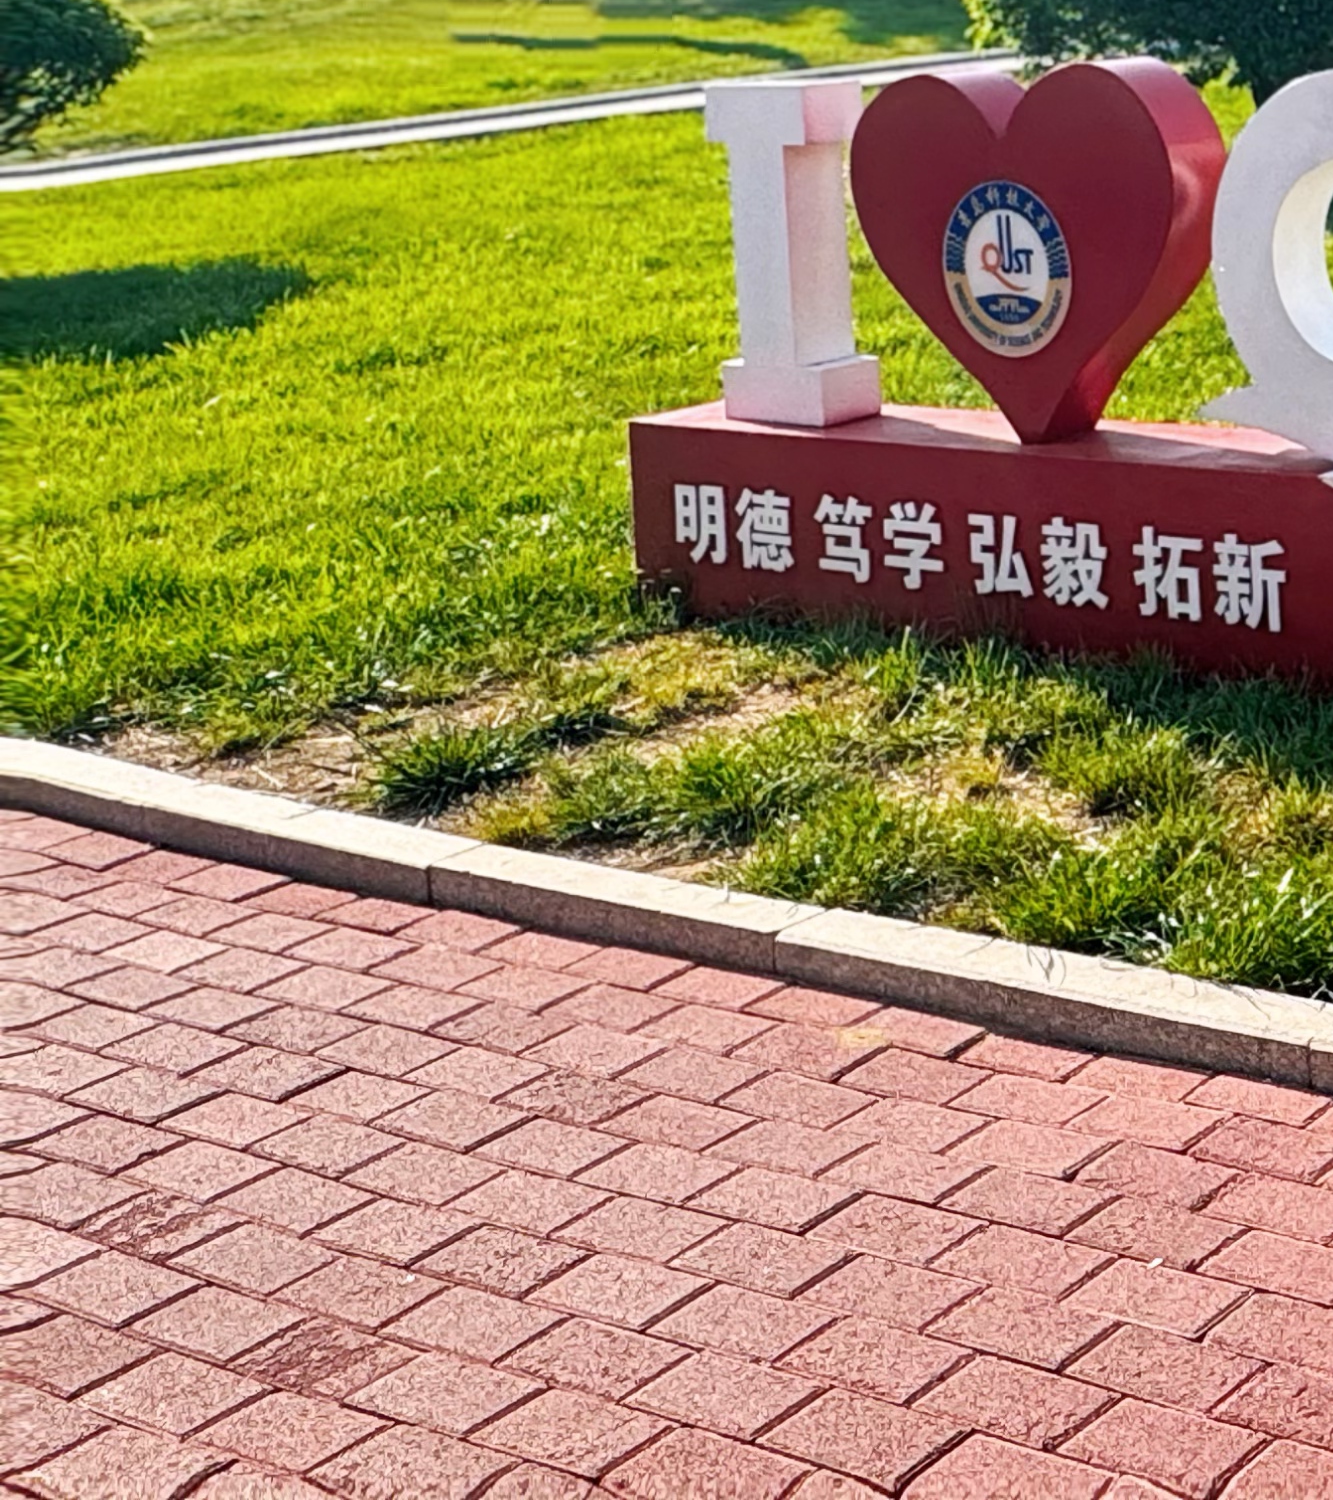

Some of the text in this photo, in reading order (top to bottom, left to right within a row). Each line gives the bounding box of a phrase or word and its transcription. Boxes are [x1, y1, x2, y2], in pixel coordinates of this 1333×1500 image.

[704, 80, 882, 427] I
[674, 483, 1287, 634] 明德 笃学 弘毅 拓新
